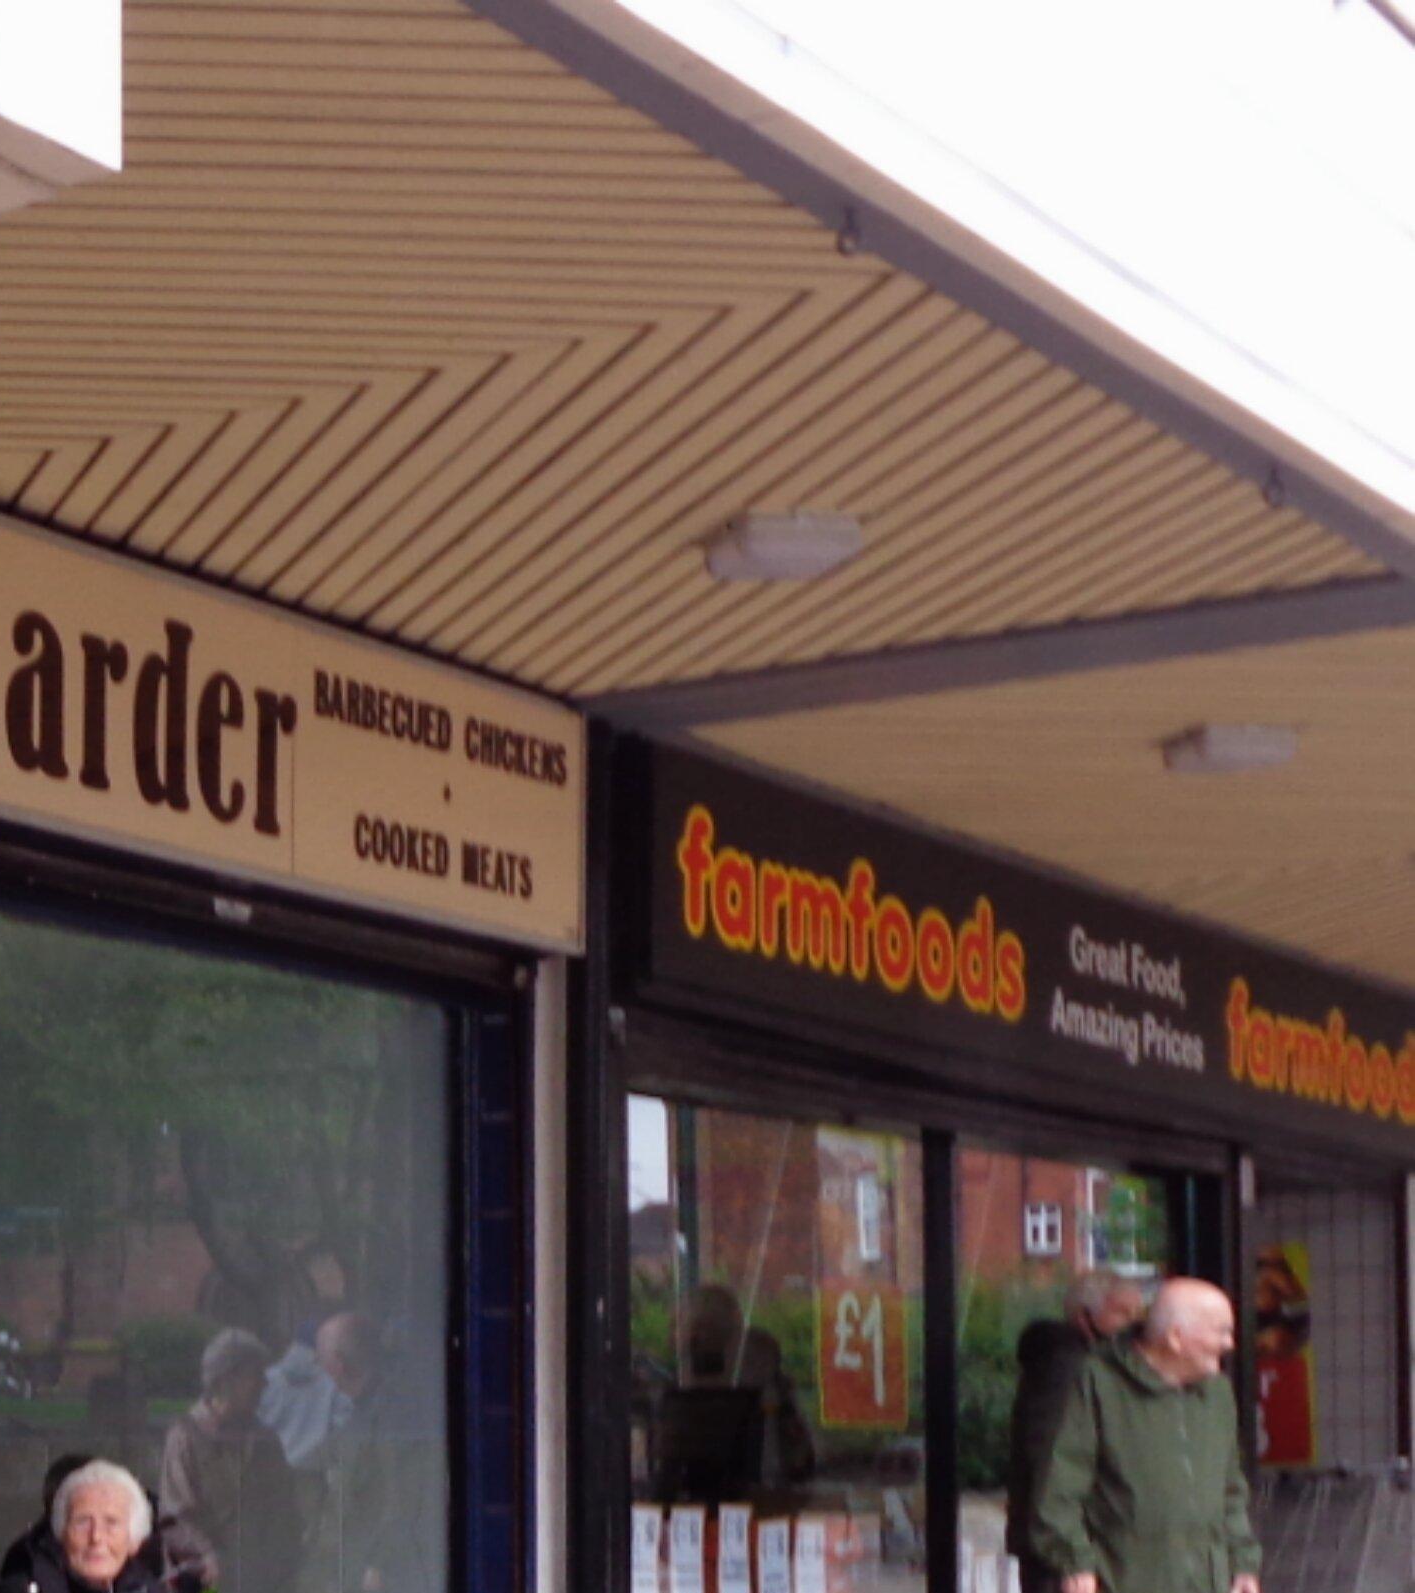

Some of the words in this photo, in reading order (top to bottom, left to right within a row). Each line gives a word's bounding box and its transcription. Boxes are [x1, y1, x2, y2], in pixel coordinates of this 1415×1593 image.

[314, 668, 452, 752] BARBECUED
[464, 714, 567, 788] CHICKENS
[354, 813, 450, 878] COOKED
[462, 840, 533, 900] MEATS
[678, 804, 1027, 1024] farmfoods
[1070, 924, 1128, 987] Great
[1130, 943, 1187, 1010] Food,
[1051, 986, 1139, 1066] Amazing
[1142, 1011, 1206, 1073] Prices
[834, 1289, 885, 1407] £1
